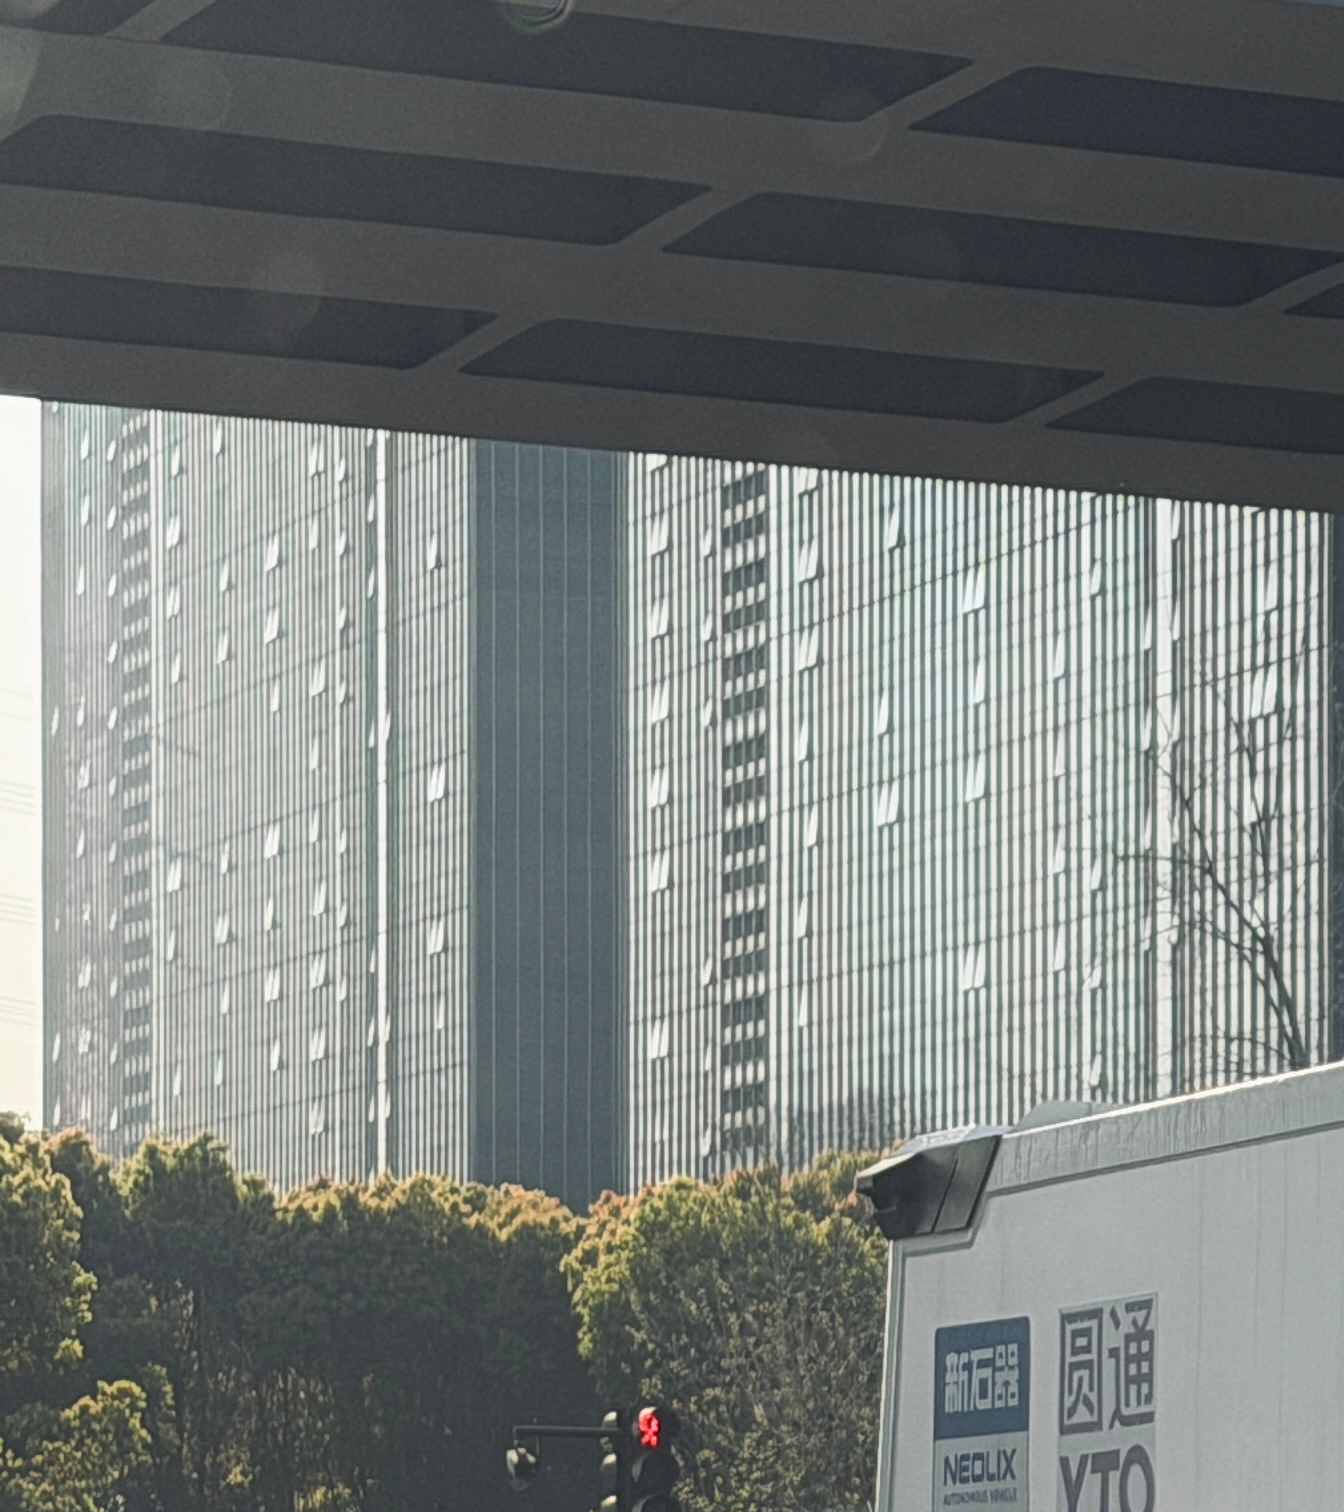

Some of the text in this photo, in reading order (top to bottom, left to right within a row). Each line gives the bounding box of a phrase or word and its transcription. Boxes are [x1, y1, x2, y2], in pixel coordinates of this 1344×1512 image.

[944, 1342, 1020, 1414] 新石器
[1059, 1297, 1155, 1436] 圆通
[943, 1448, 1017, 1487] NEOLIX
